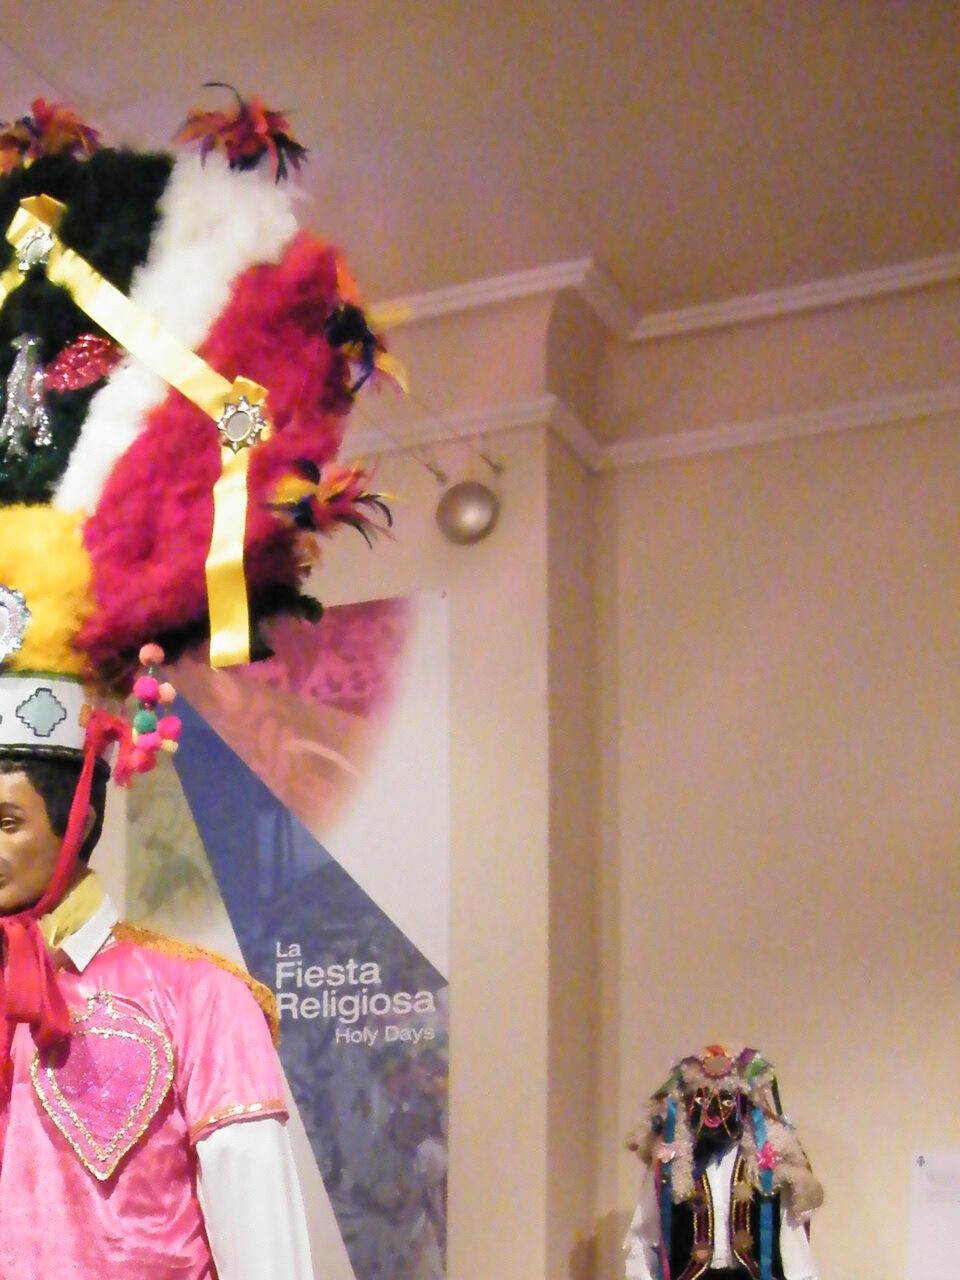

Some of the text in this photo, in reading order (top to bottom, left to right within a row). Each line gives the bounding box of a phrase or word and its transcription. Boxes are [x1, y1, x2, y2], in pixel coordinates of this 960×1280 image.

[276, 941, 302, 958] La
[275, 958, 382, 989] Fiesta
[275, 988, 437, 1024] Religiosa
[335, 1025, 436, 1046] Holy Days
